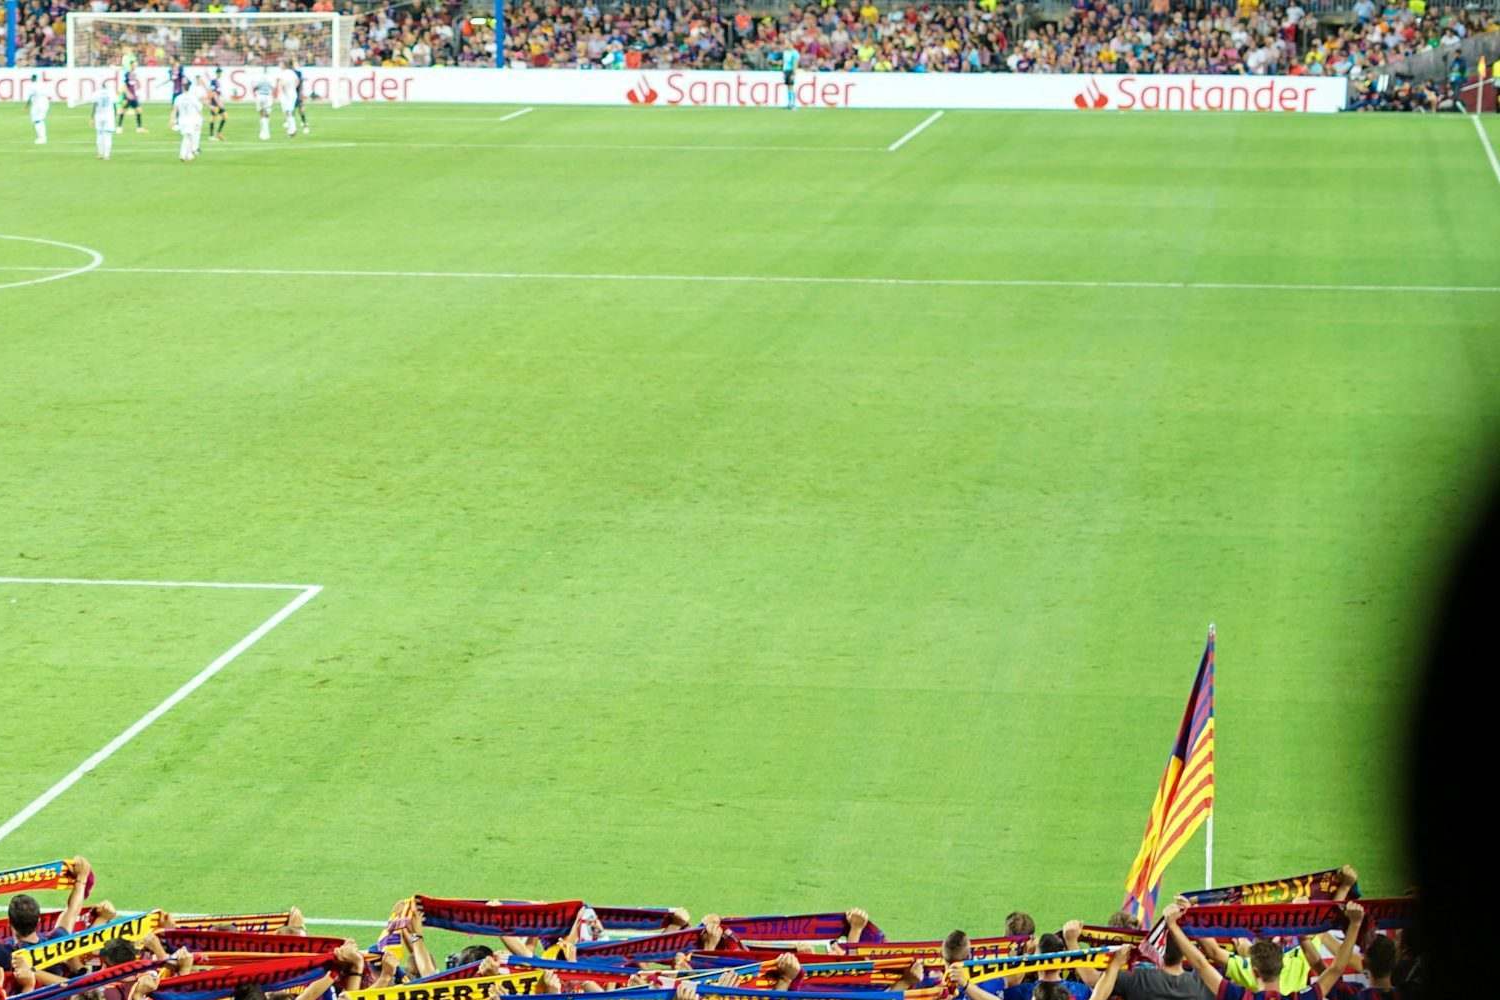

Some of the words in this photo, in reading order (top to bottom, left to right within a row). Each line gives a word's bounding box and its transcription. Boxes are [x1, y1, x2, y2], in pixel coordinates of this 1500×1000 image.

[667, 74, 856, 106] Santander
[1118, 78, 1316, 112] Santander
[30, 917, 146, 967] LLIBERTAT
